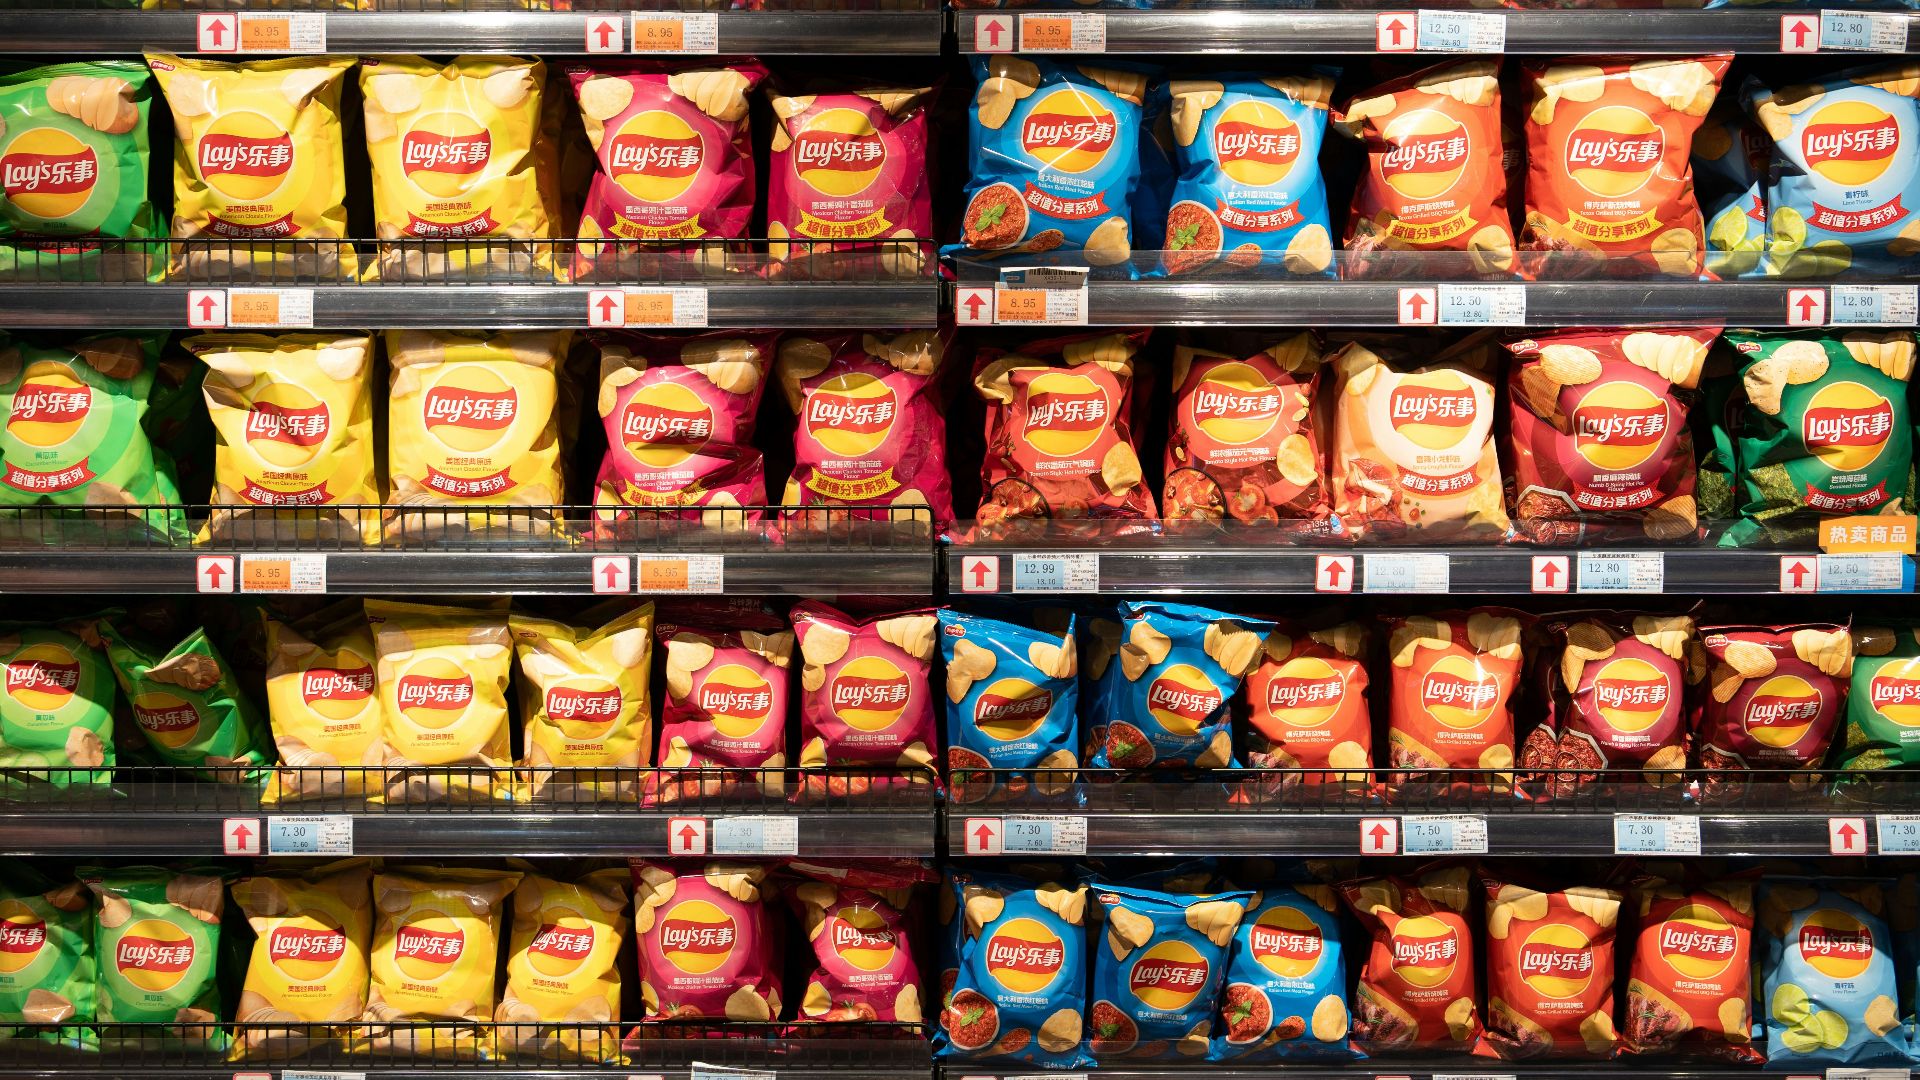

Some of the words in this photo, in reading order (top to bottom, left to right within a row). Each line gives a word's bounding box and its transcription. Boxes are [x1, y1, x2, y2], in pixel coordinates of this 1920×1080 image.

[254, 26, 280, 37] 8.95
[647, 27, 673, 38] 8.95
[1035, 25, 1061, 37] 8.95
[1428, 23, 1461, 35] 12.50
[1830, 23, 1863, 35] 12.80
[1027, 121, 1114, 144] Lay's乐事
[1218, 130, 1298, 157] Lay's乐事
[1807, 127, 1897, 157] Lay's乐事
[202, 143, 290, 170] Lay's乐事
[405, 140, 489, 168] Lay's乐事
[613, 143, 700, 171] Lay's乐事
[798, 138, 883, 166] Lay's乐事
[1570, 138, 1661, 166] Lay's乐事
[4, 159, 95, 190] Lay's乐事
[1027, 190, 1099, 215] 超值分享系列
[214, 220, 290, 237] 超值分享系列
[413, 217, 489, 237] 超值分享系列
[806, 218, 880, 238] 超值分享系列
[1220, 208, 1294, 227] 超值分享系列
[1391, 217, 1466, 238] 超值分享系列
[1572, 218, 1650, 238] 超值分享系列
[1818, 206, 1898, 228] 超值分享系列
[620, 224, 694, 238] 超值分享系列
[1010, 298, 1036, 308] 8.95
[1449, 296, 1482, 307] 12.50
[1842, 296, 1873, 306] 12.80
[427, 395, 515, 422] Lay's乐事
[810, 400, 893, 426] Lay's乐事
[1027, 399, 1106, 427] Lay's乐事
[1196, 390, 1280, 415] Lay's乐事
[1394, 395, 1476, 421] Lay's乐事
[249, 411, 326, 437] Lay's乐事
[625, 411, 710, 440] Lay's乐事
[1579, 415, 1665, 441] Lay's乐事
[1808, 411, 1891, 443] Lay's乐事
[12, 467, 84, 488] 超值分享系列
[430, 474, 505, 494] 超值分享系列
[817, 475, 887, 495] 超值分享系列
[1401, 471, 1474, 491] 超值分享系列
[249, 485, 323, 504] 超值分享系列
[1577, 488, 1652, 508] 超值分享系列
[1810, 490, 1881, 512] 超值分享系列
[1829, 524, 1908, 544] 热卖商品
[255, 568, 280, 578] 8.95
[1025, 563, 1055, 574] 12.99
[1589, 563, 1620, 573] 12.80
[1828, 564, 1858, 574] 12.50
[8, 665, 78, 688] Lay's乐事
[305, 672, 374, 697] Lay's乐事
[400, 682, 471, 705] Lay's乐事
[703, 689, 770, 713] Lay's乐事
[835, 683, 907, 707] Lay's乐事
[1151, 685, 1219, 714] Lay's乐事
[1270, 681, 1342, 705] Lay's乐事
[1426, 679, 1497, 703] Lay's乐事
[1874, 682, 1920, 703] Lay's
[549, 692, 620, 717] Lay's乐事
[978, 696, 1048, 719] Lay's乐事
[1748, 701, 1818, 724] Lay's乐事
[281, 826, 305, 837] 7.30
[1016, 825, 1040, 835] 7.30
[1415, 825, 1440, 835] 7.50
[1628, 825, 1653, 835] 7.30
[1890, 825, 1916, 835] 7.30
[273, 933, 345, 957] Lay's乐事
[398, 933, 462, 957] Lay's乐事
[663, 926, 734, 949] Lay's乐事
[1255, 931, 1320, 954] Lay's乐事
[1663, 928, 1735, 953] Lay's乐事
[1803, 933, 1872, 954] Lay's乐事
[119, 943, 193, 966] Lay's乐事
[990, 943, 1061, 967] Lay's乐事
[1395, 938, 1456, 964] Lay's乐事
[1523, 950, 1592, 974] Lay's乐事
[1134, 965, 1206, 987] Lay's乐事
